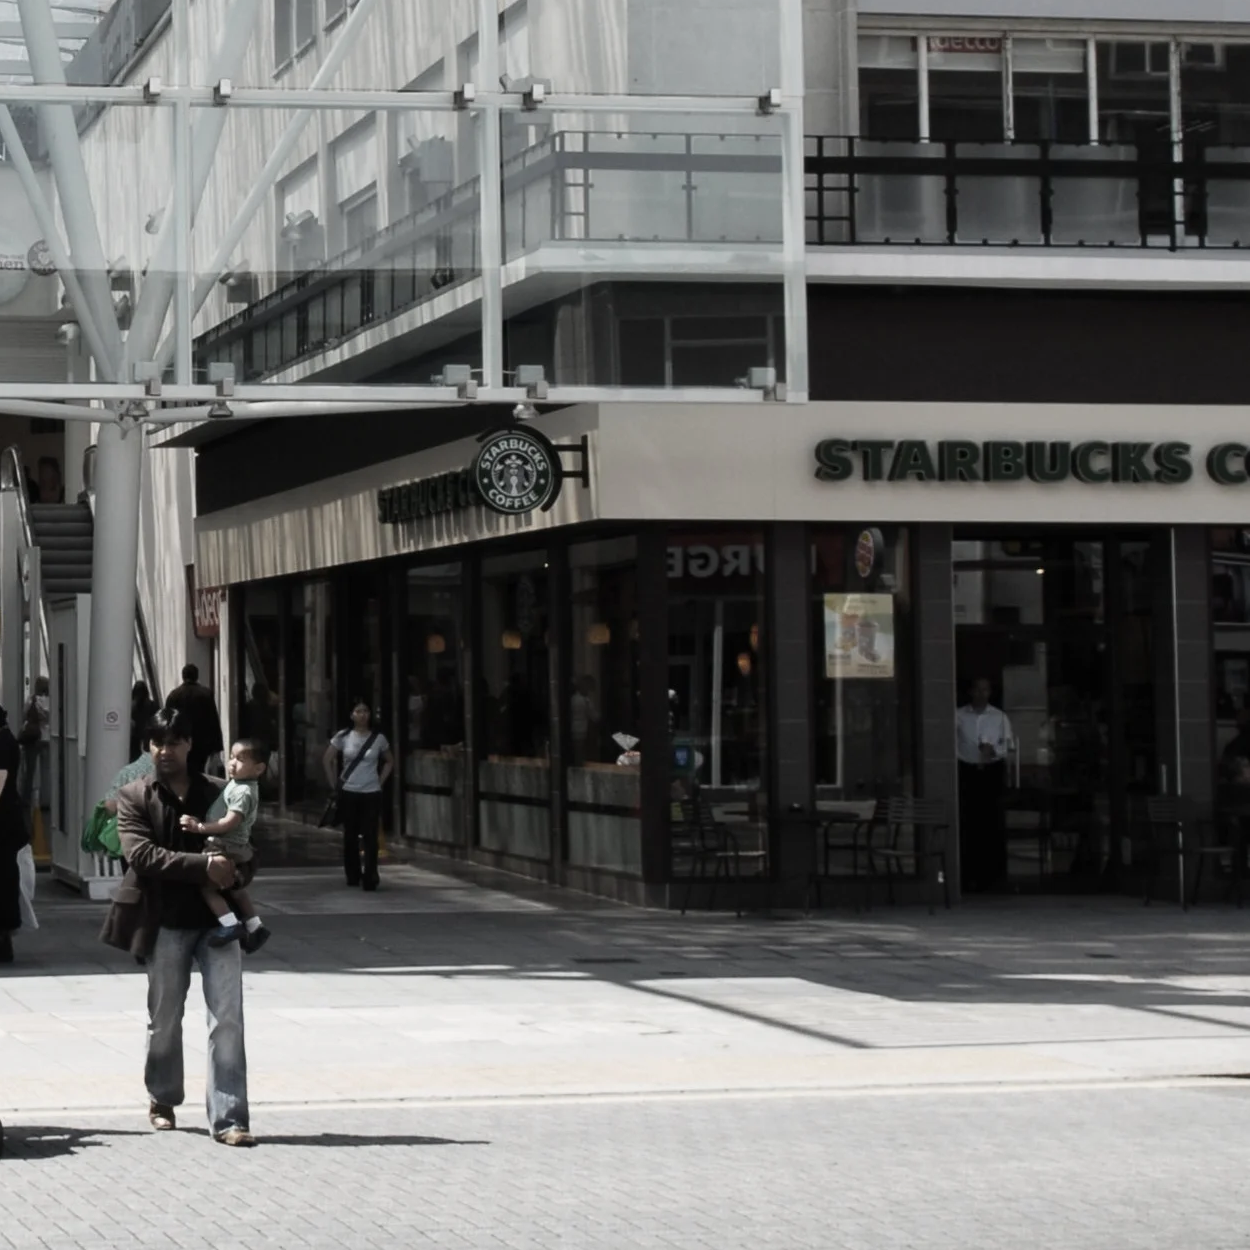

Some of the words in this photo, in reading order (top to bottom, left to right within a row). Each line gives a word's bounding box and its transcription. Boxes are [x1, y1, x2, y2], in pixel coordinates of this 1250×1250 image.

[481, 439, 547, 471] STARBUCKS
[814, 439, 1193, 484] STARBUCKS
[488, 488, 539, 508] COFFEE
